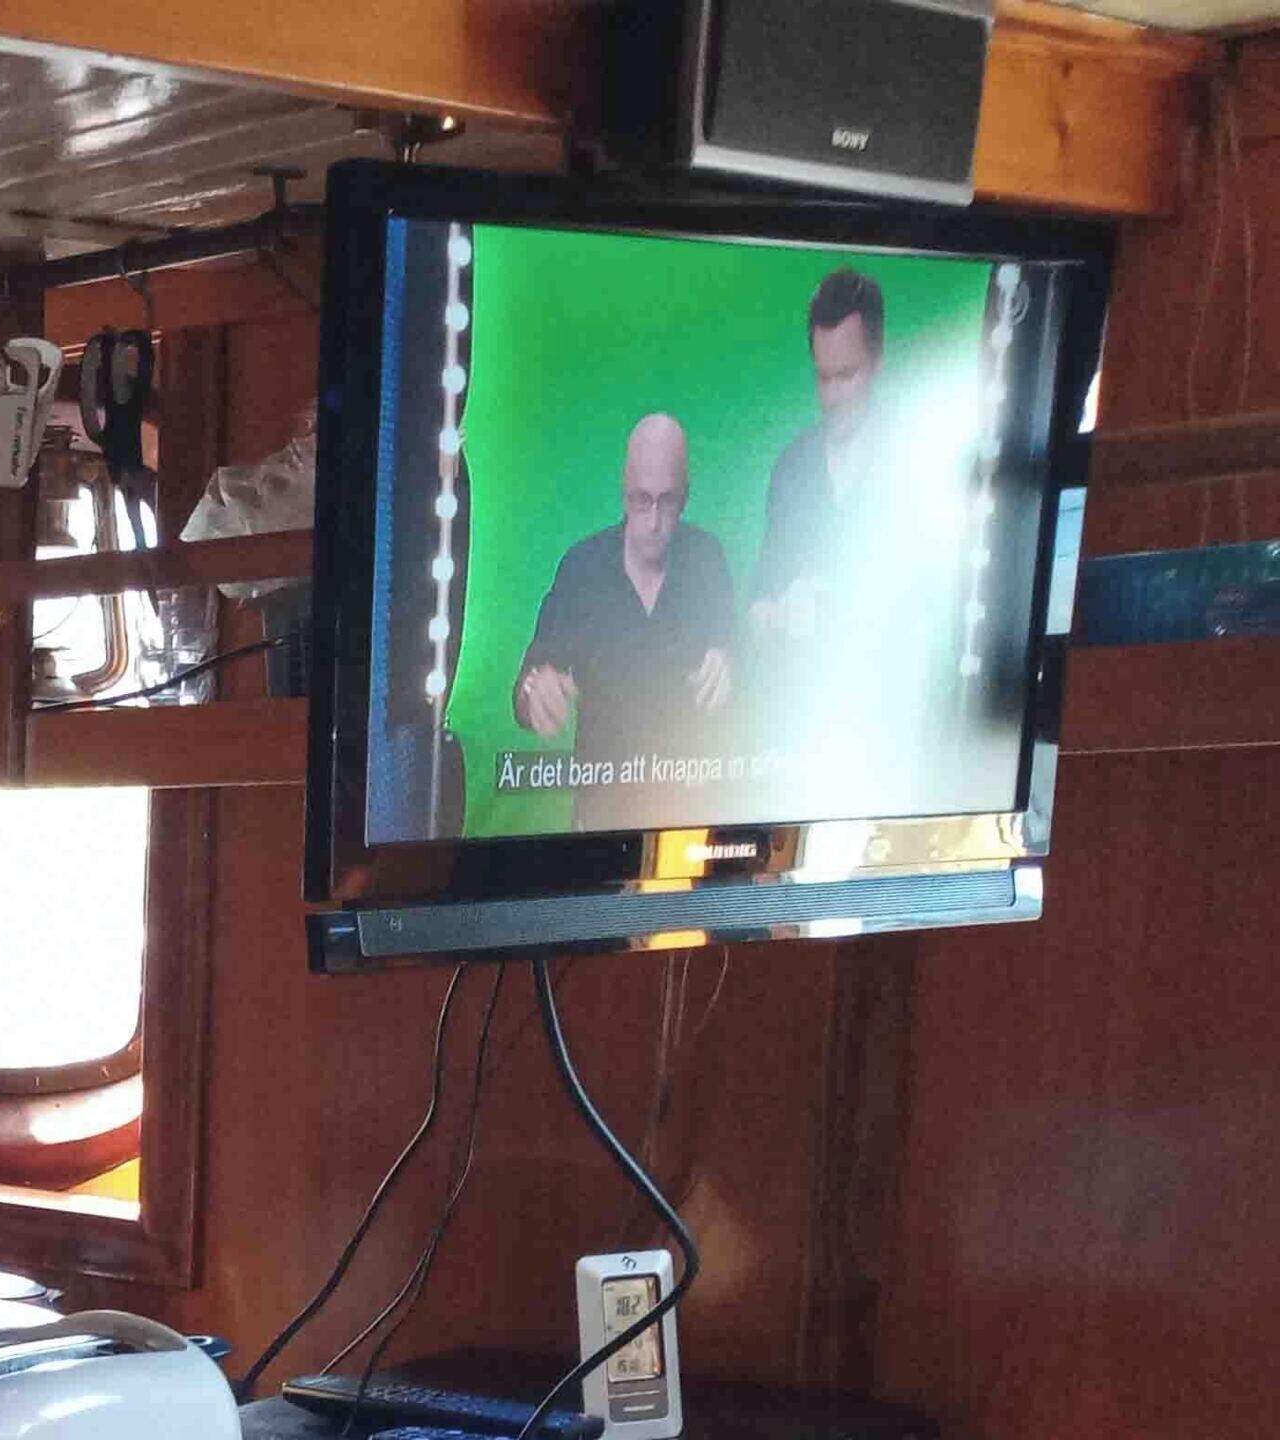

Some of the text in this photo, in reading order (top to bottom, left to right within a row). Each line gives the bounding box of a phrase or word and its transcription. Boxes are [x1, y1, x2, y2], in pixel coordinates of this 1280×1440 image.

[498, 752, 524, 788] Är
[530, 757, 562, 787] det
[568, 756, 614, 787] bara
[619, 754, 645, 784] att
[652, 753, 721, 787] knappa
